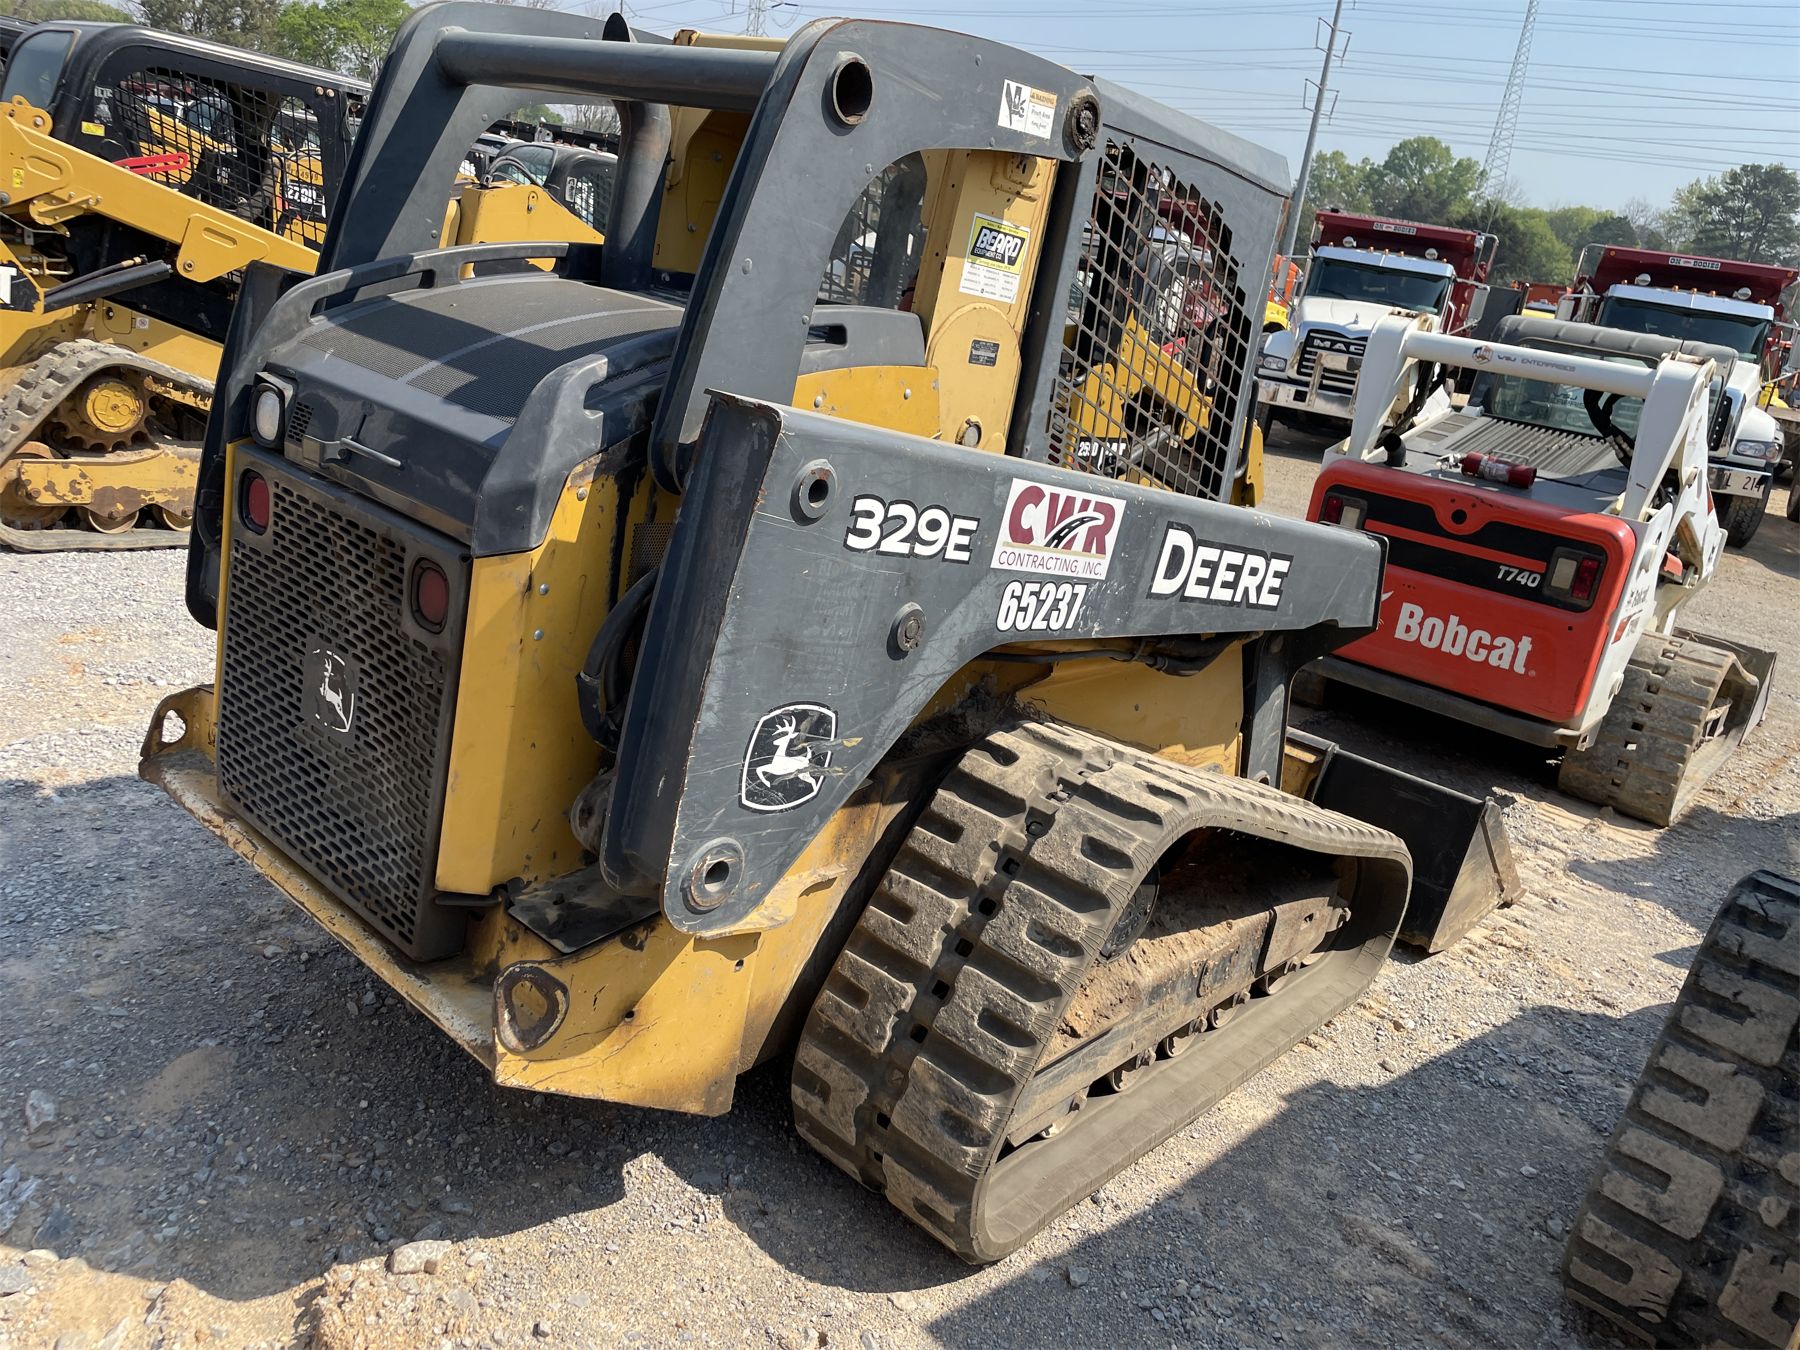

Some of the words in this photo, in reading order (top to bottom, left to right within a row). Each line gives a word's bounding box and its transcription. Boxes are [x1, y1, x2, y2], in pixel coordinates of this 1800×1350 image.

[976, 228, 1022, 265] BEARD
[0, 266, 17, 305] T
[1313, 339, 1365, 353] MAC
[845, 495, 980, 563] 329E
[1008, 485, 1116, 555] CWR
[998, 550, 1080, 575] CONTRACTING,
[1083, 560, 1103, 577] INC.
[1148, 523, 1293, 609] DEERE
[1497, 565, 1541, 588] T740
[997, 580, 1088, 632] 65237
[1394, 602, 1533, 675] Bobcat
